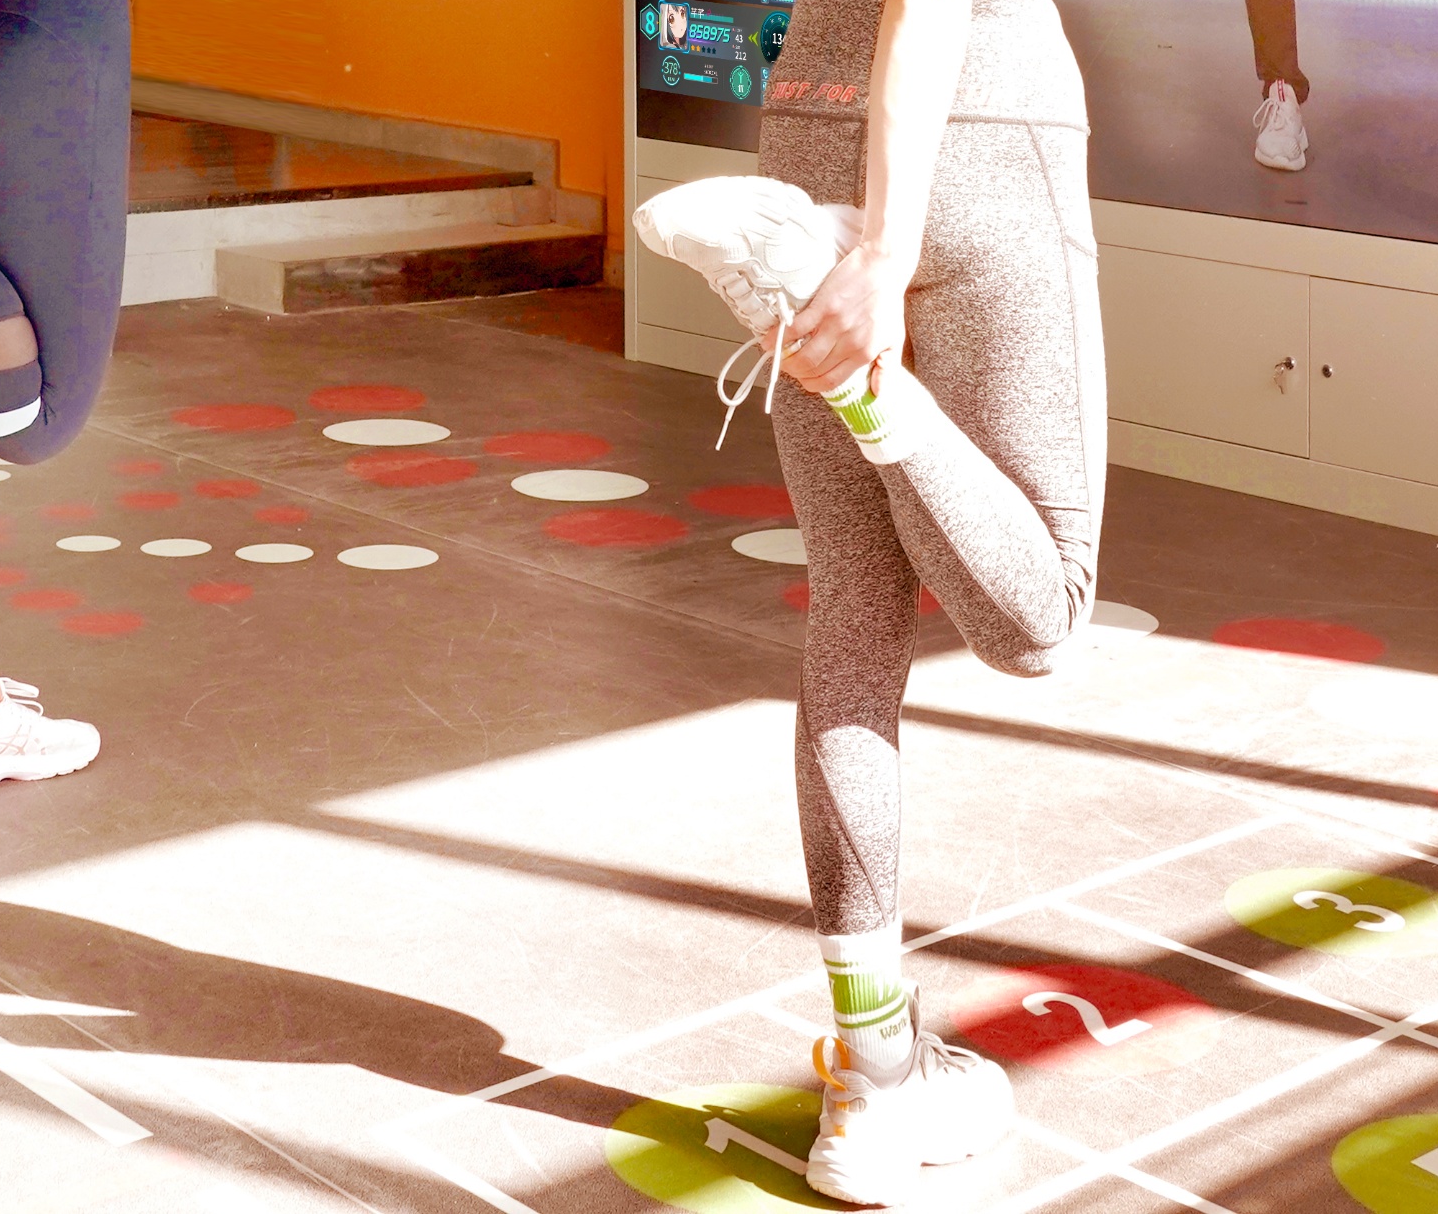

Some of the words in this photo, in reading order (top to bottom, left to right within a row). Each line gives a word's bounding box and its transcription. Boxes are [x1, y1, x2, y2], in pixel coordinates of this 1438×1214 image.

[645, 11, 655, 35] 8
[689, 24, 731, 43] 858975
[735, 34, 744, 43] 43
[735, 51, 747, 60] 212
[663, 62, 678, 75] 378
[772, 82, 810, 101] JUST
[811, 84, 857, 103] FOR
[1293, 889, 1406, 933] 3
[1022, 990, 1153, 1047] 2
[704, 1116, 808, 1177] 1
